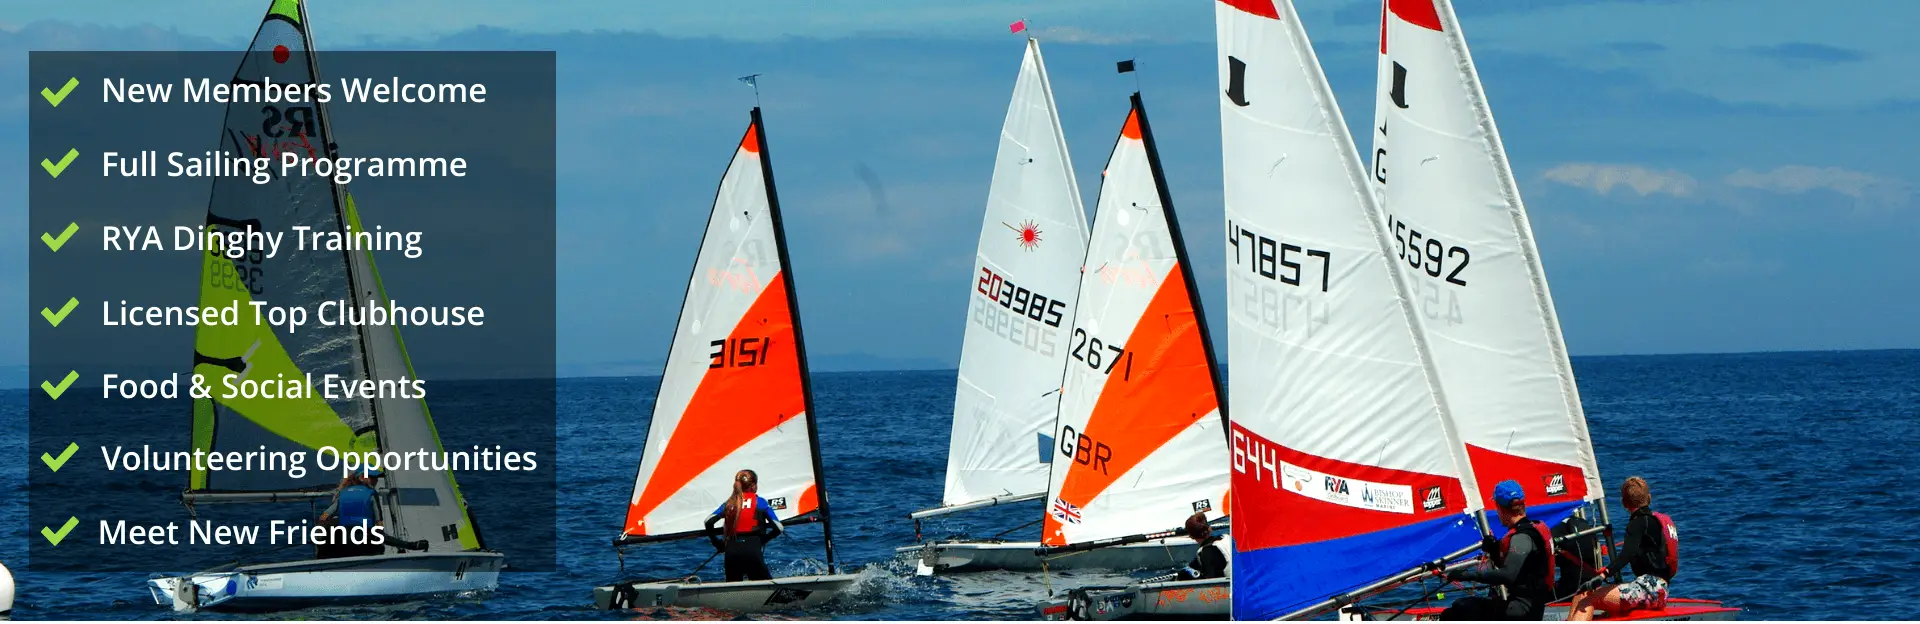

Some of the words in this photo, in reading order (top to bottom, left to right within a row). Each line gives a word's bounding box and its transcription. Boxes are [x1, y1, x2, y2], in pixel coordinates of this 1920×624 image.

[1229, 219, 1331, 292] 47857
[1388, 214, 1470, 287] 5592
[977, 266, 1066, 328] 203985
[709, 337, 770, 369] 3151
[1072, 327, 1133, 381] 2671
[1060, 425, 1112, 475] GBR
[1325, 476, 1349, 495] RYA
[1374, 489, 1404, 499] BISHOP
[1374, 496, 1410, 507] SKINNER
[770, 498, 784, 506] RS
[1195, 500, 1208, 509] RS
